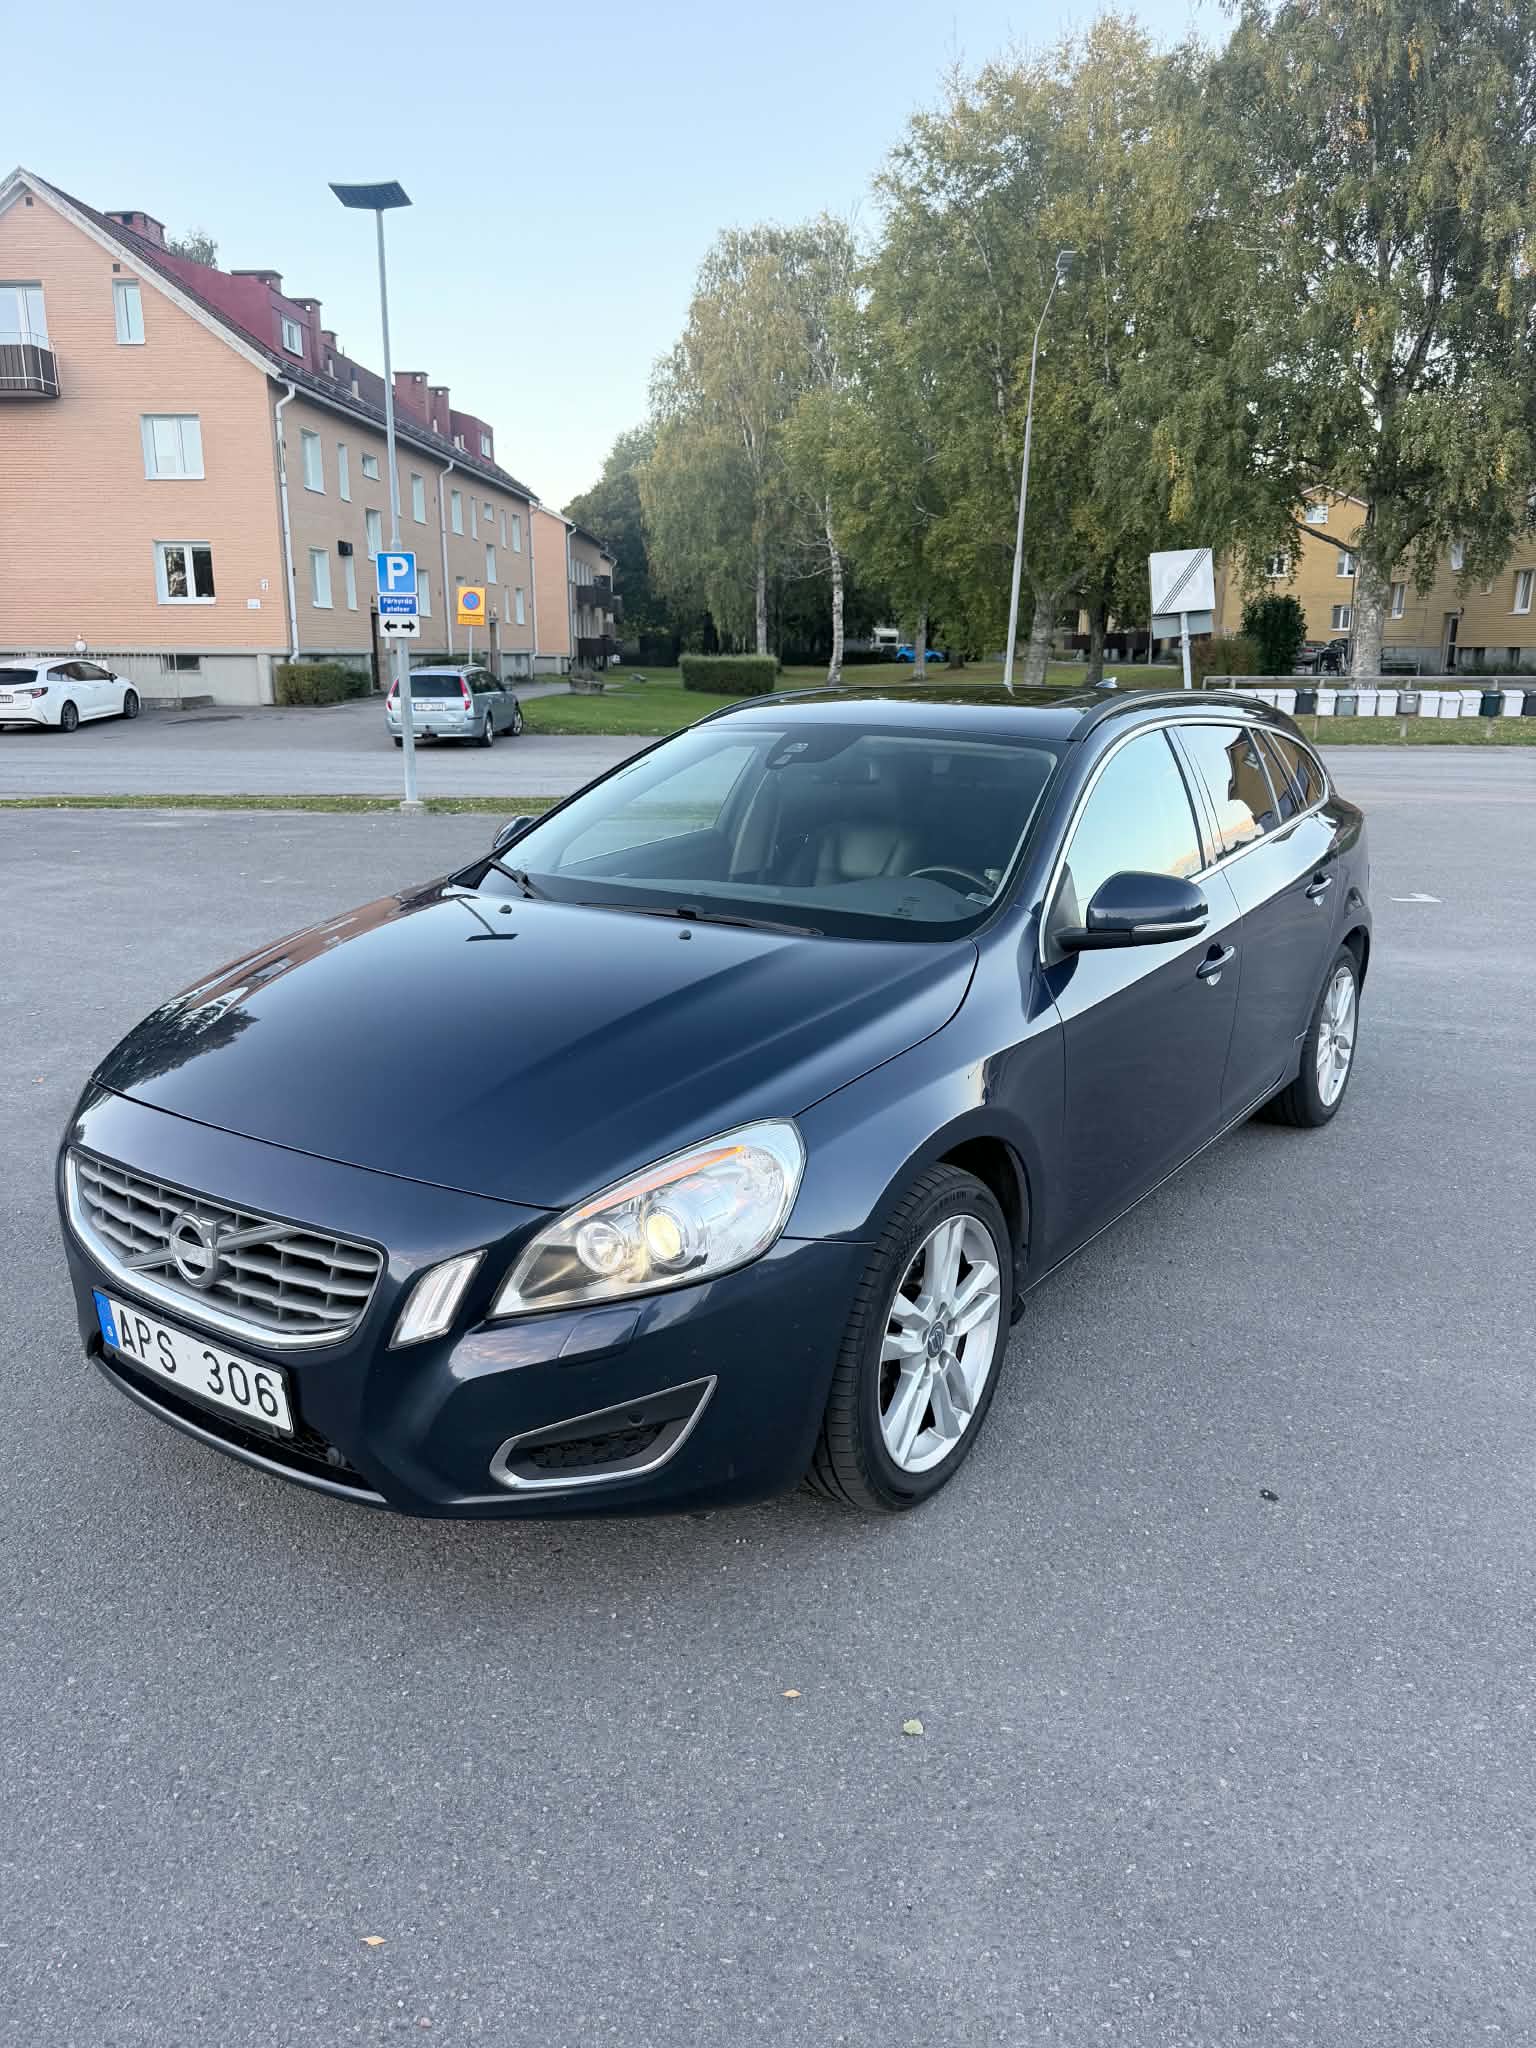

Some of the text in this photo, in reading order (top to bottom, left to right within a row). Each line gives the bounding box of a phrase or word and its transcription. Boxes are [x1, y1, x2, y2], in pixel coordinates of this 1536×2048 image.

[387, 556, 409, 590] P
[106, 1326, 113, 1337] S
[119, 1309, 279, 1418] APS 306
